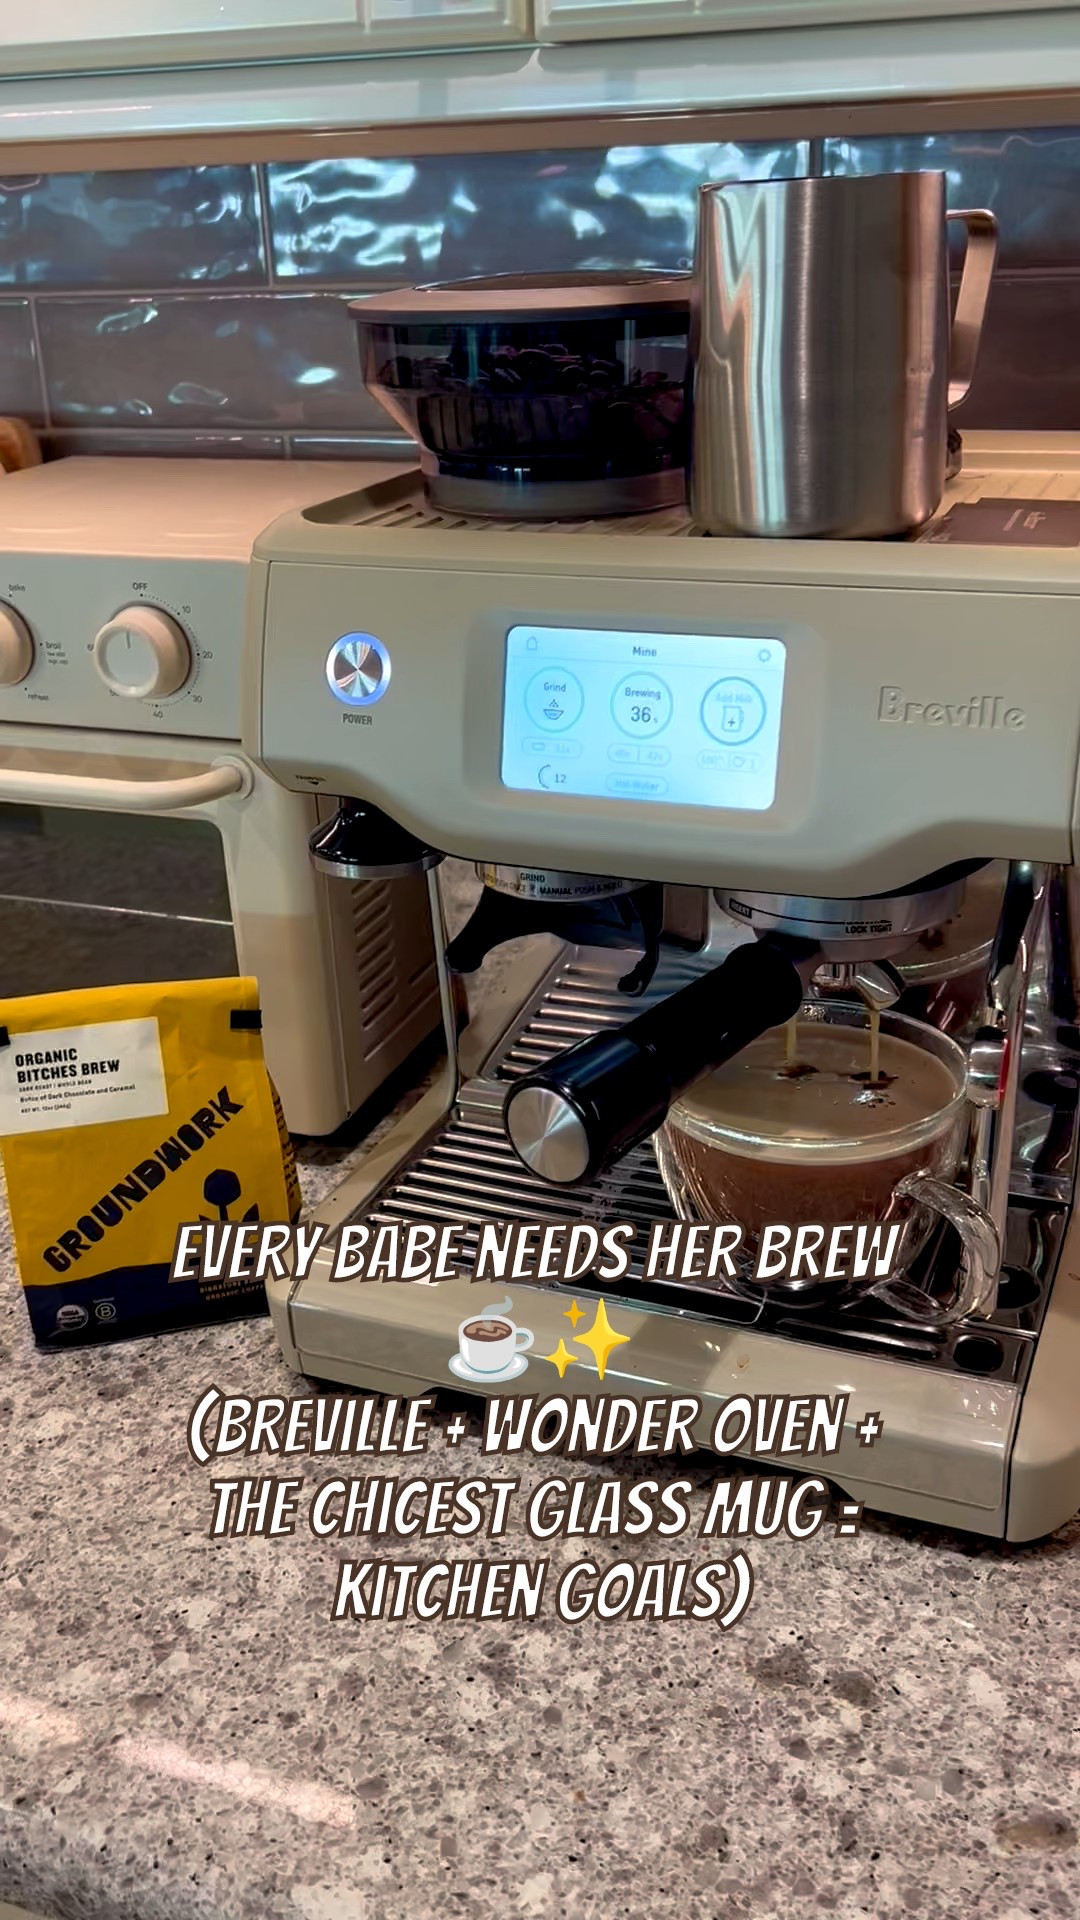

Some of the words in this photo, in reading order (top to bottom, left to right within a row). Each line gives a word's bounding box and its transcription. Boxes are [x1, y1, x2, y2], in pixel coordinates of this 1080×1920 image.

[132, 583, 148, 591] OFF
[182, 606, 191, 615] 10
[202, 651, 213, 660] 20
[632, 646, 657, 658] Mine
[543, 681, 567, 693] Grind
[193, 695, 203, 703] 30
[624, 686, 661, 701] Brewing
[878, 686, 1028, 731] Breville
[152, 711, 163, 719] 40
[343, 713, 373, 725] POWER
[553, 773, 567, 784] 12
[520, 872, 545, 882] GRIND
[539, 886, 572, 895] MANUAL
[845, 925, 868, 934] LOCK
[15, 1048, 78, 1067] ORGANIC
[17, 1064, 77, 1083] BITCHES
[81, 1059, 120, 1076] BREW
[48, 1092, 63, 1100] Dark
[63, 1089, 96, 1098] Chocolate
[109, 1084, 136, 1093] Caramel
[43, 1086, 244, 1273] GROUNDWORK
